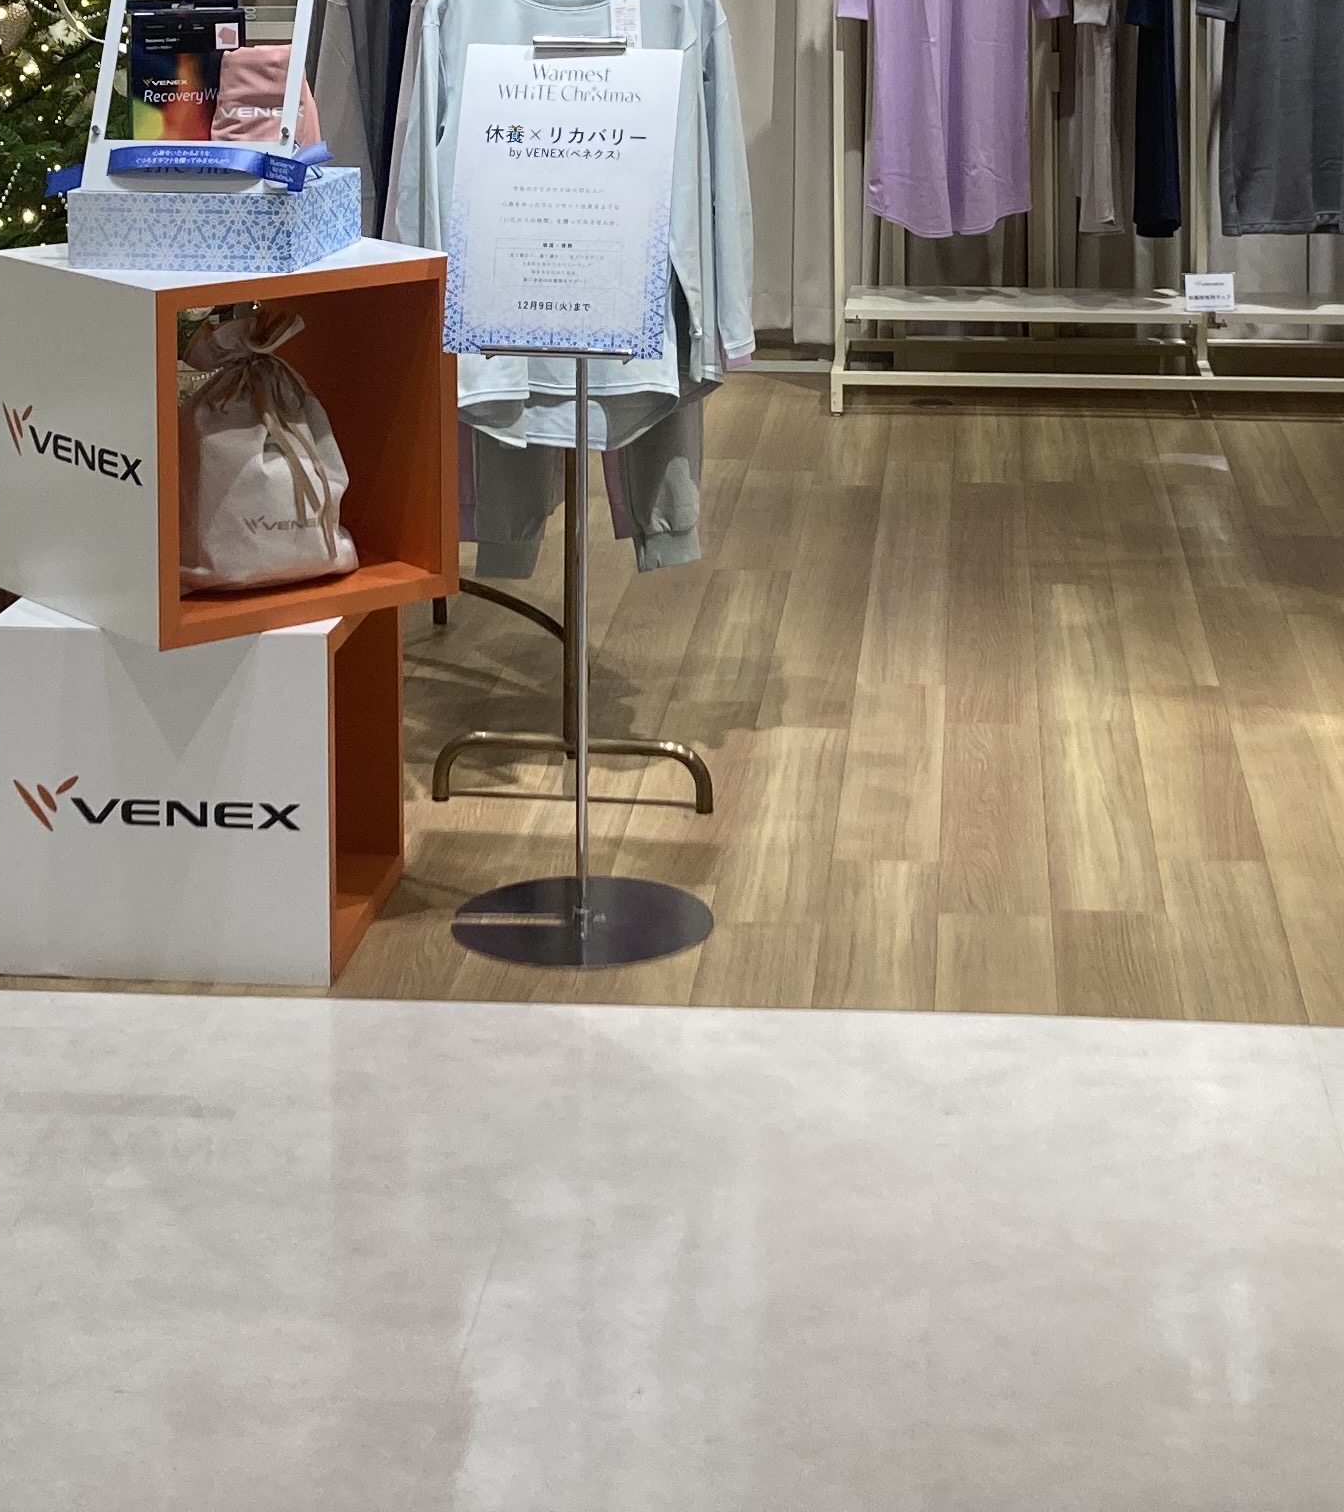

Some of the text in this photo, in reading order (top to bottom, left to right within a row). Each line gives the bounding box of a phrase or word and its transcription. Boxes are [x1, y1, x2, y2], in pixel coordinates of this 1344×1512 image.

[532, 63, 612, 83] Warmest
[560, 85, 642, 103] Christmas
[508, 147, 522, 158] by
[28, 424, 143, 486] VENEX
[71, 797, 300, 831] VENEX
